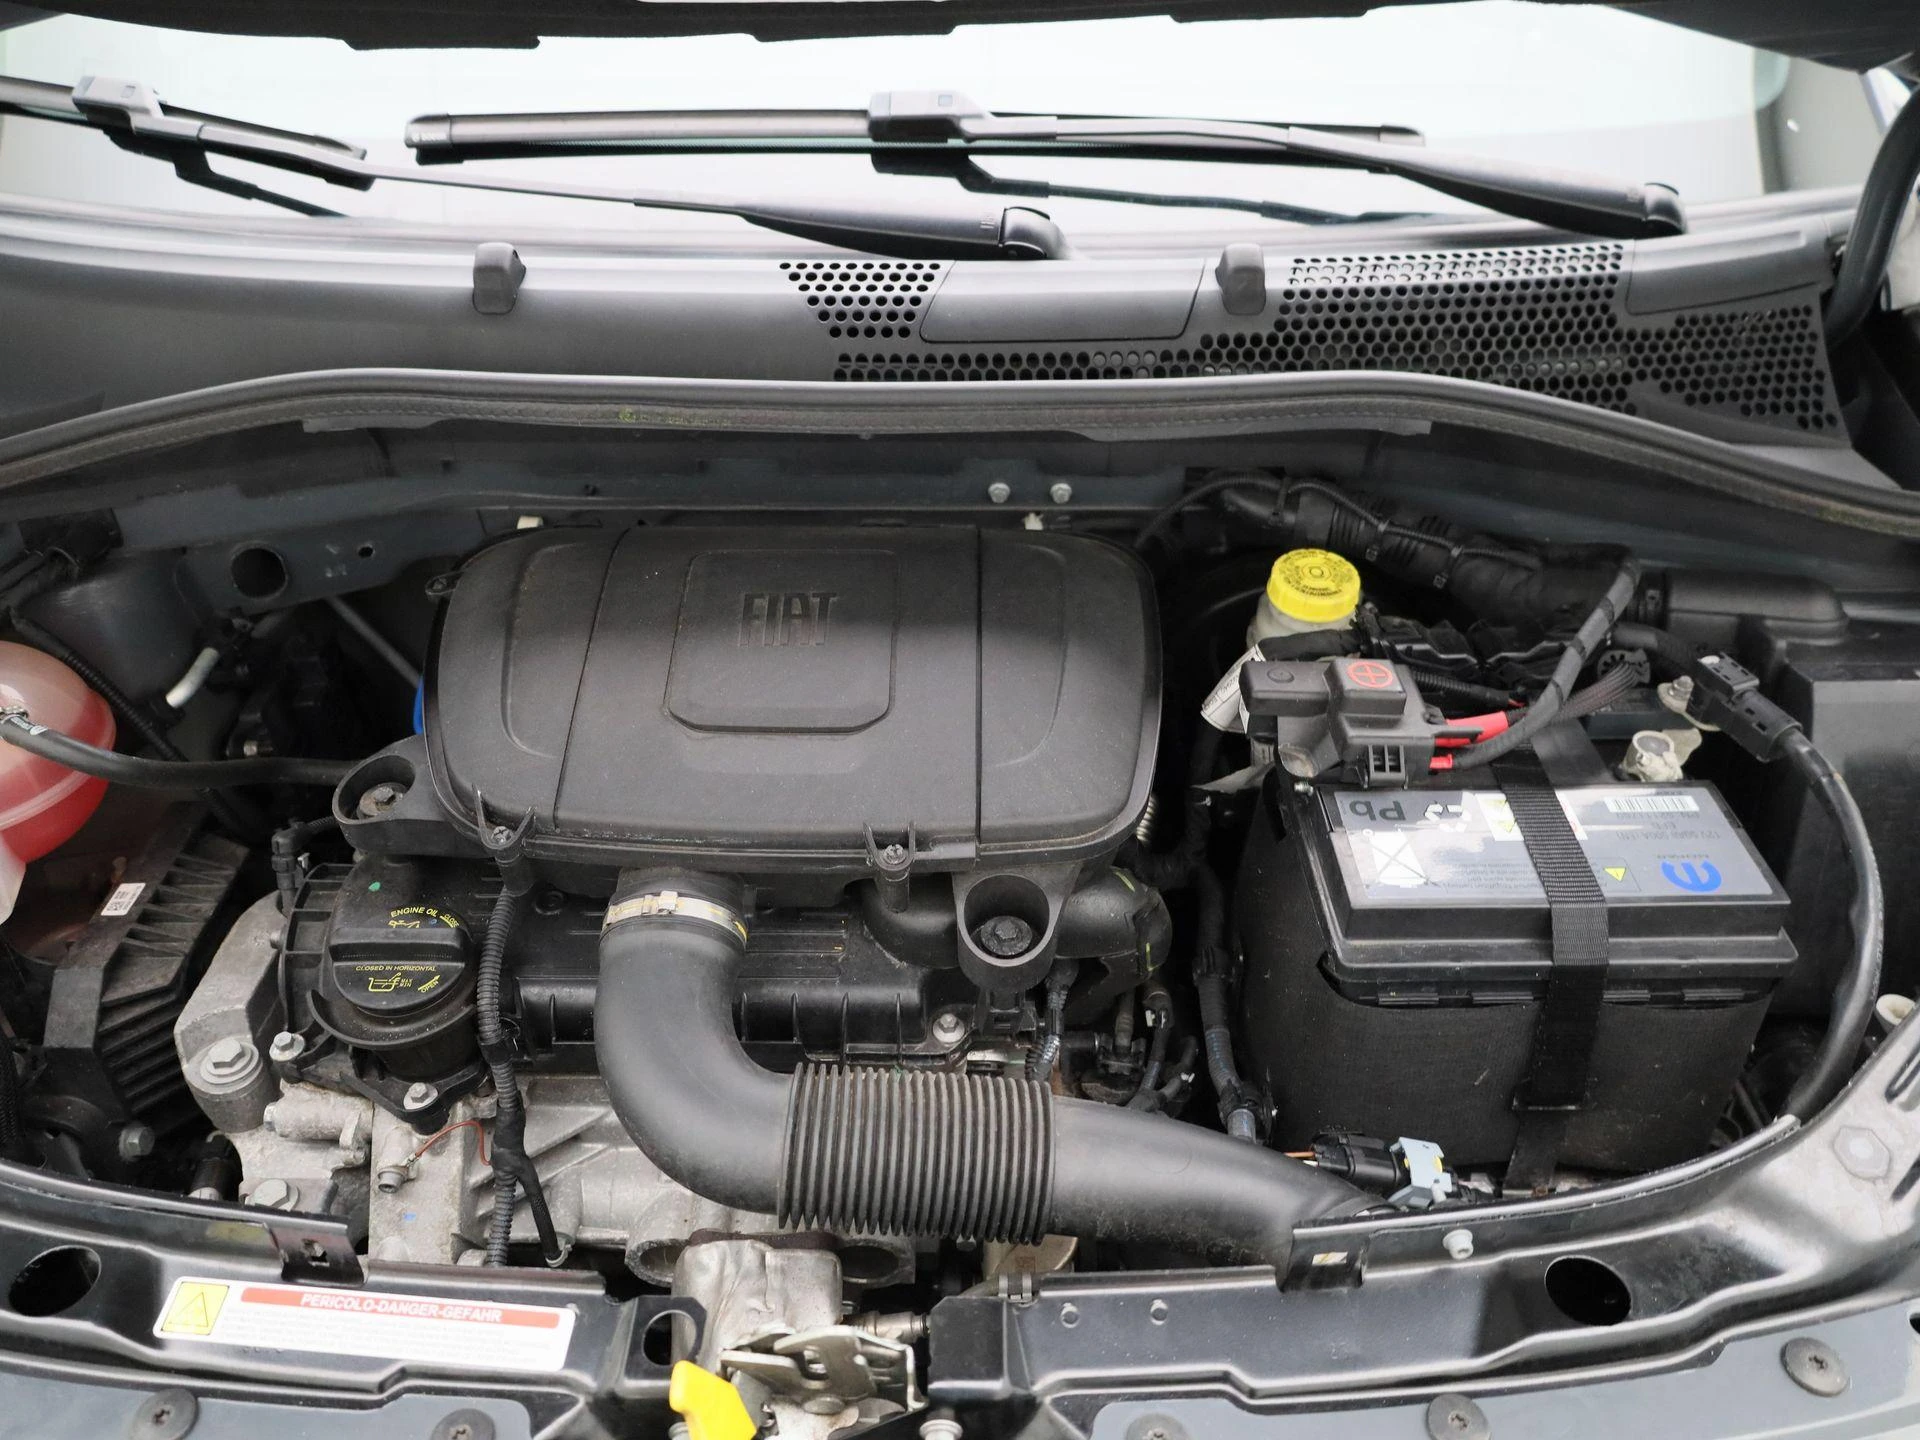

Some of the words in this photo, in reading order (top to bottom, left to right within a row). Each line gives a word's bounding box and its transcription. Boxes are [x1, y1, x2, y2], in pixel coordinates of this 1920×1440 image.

[738, 592, 838, 646] FIAT
[1349, 800, 1406, 821] Pb
[390, 906, 425, 918] ENGINE
[426, 908, 439, 918] OIL
[420, 980, 439, 993] OPEN
[300, 1293, 503, 1323] PERICOLO-DANGER-GEFAHR
